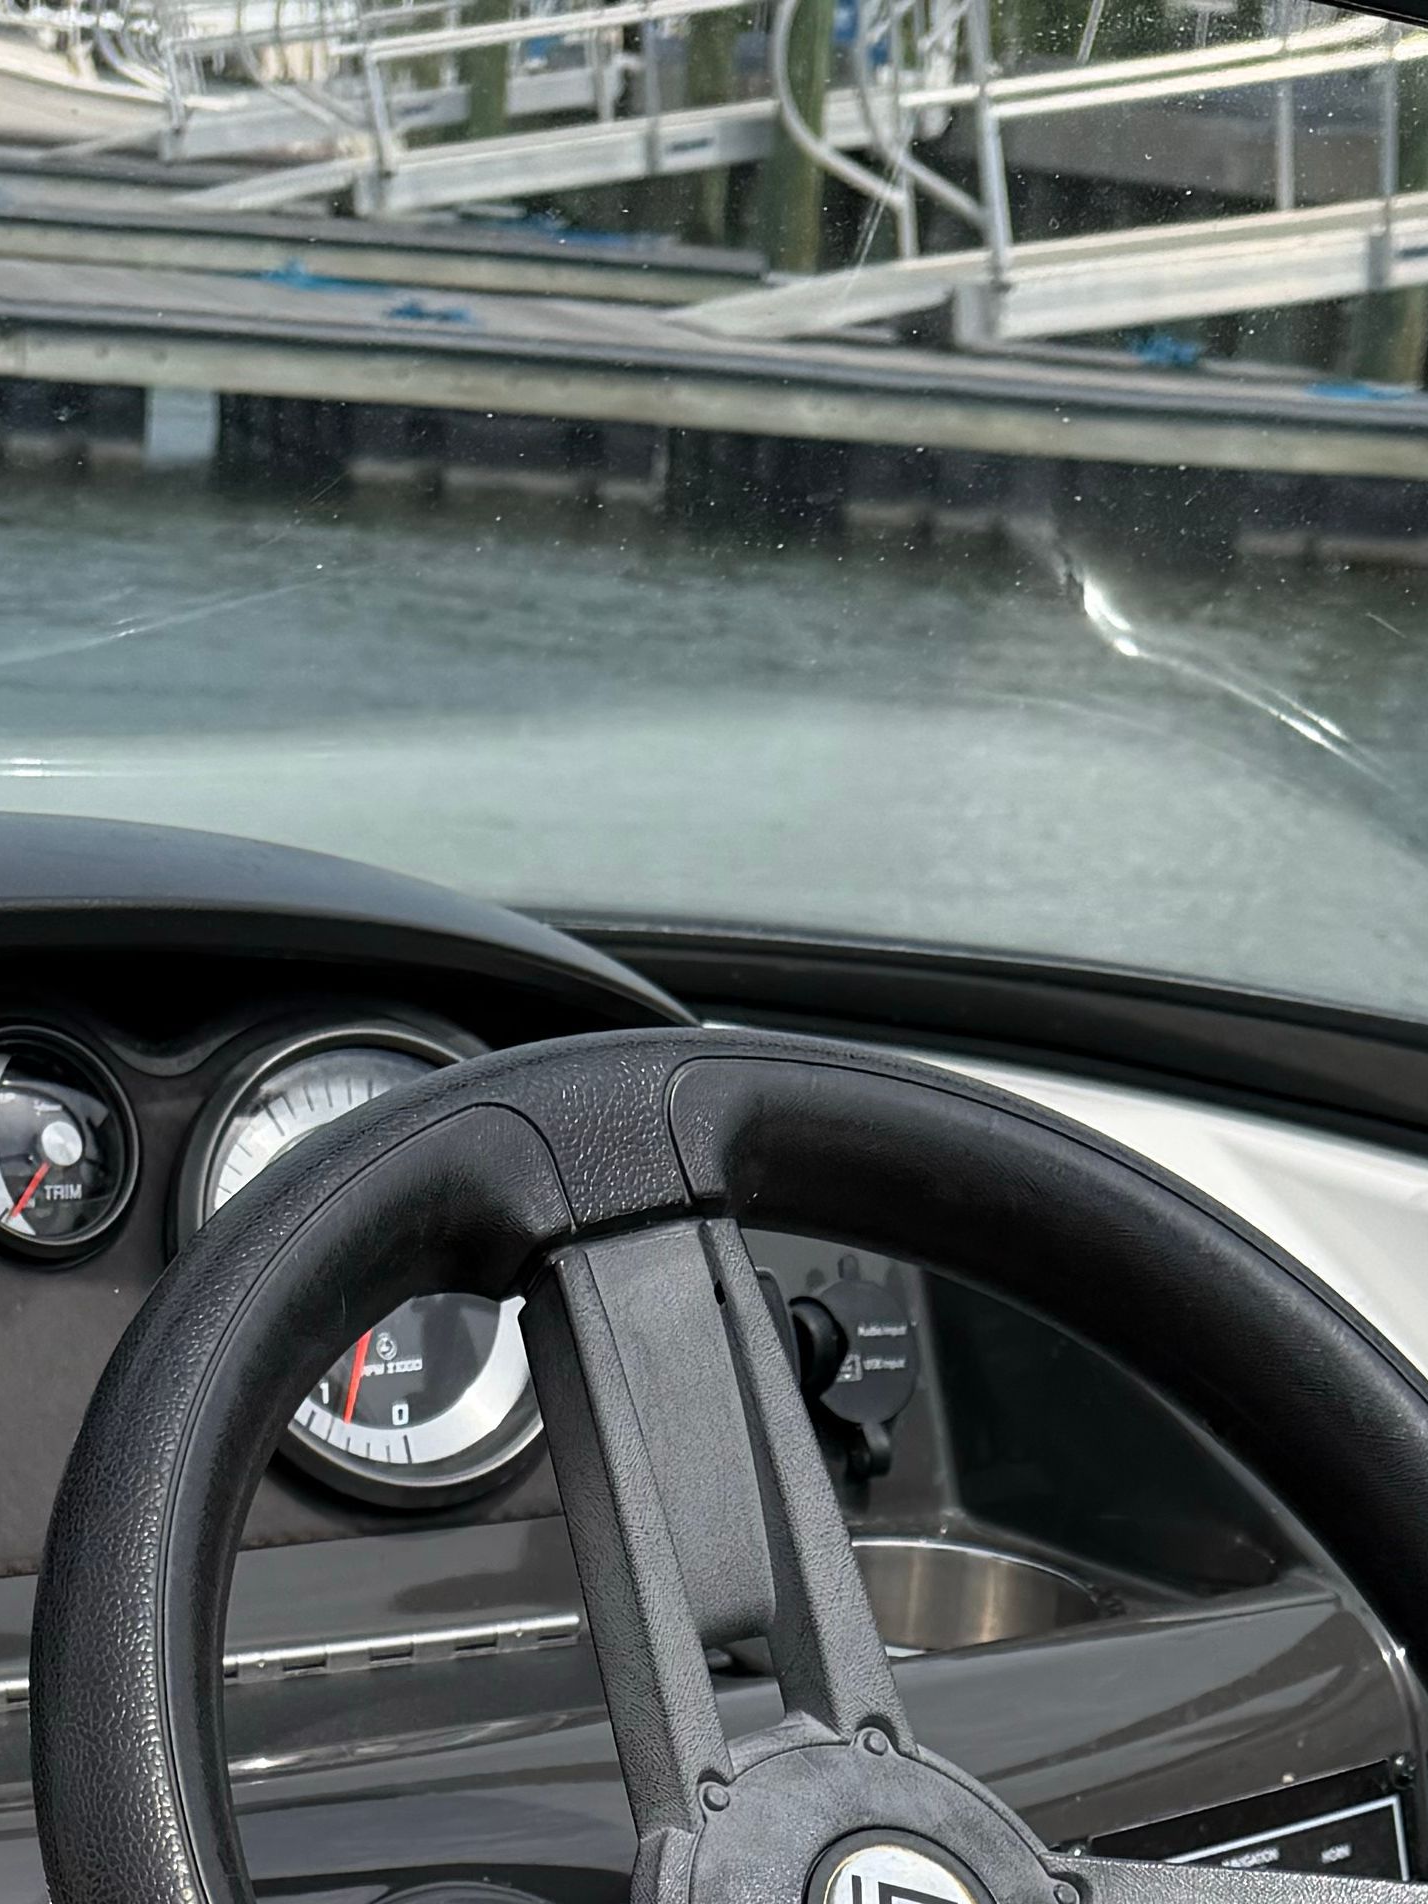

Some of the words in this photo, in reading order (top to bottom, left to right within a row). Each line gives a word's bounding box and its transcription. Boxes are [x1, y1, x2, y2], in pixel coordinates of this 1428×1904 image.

[44, 1184, 83, 1200] TRIM
[319, 1382, 330, 1404] 1
[392, 1403, 409, 1426] 0
